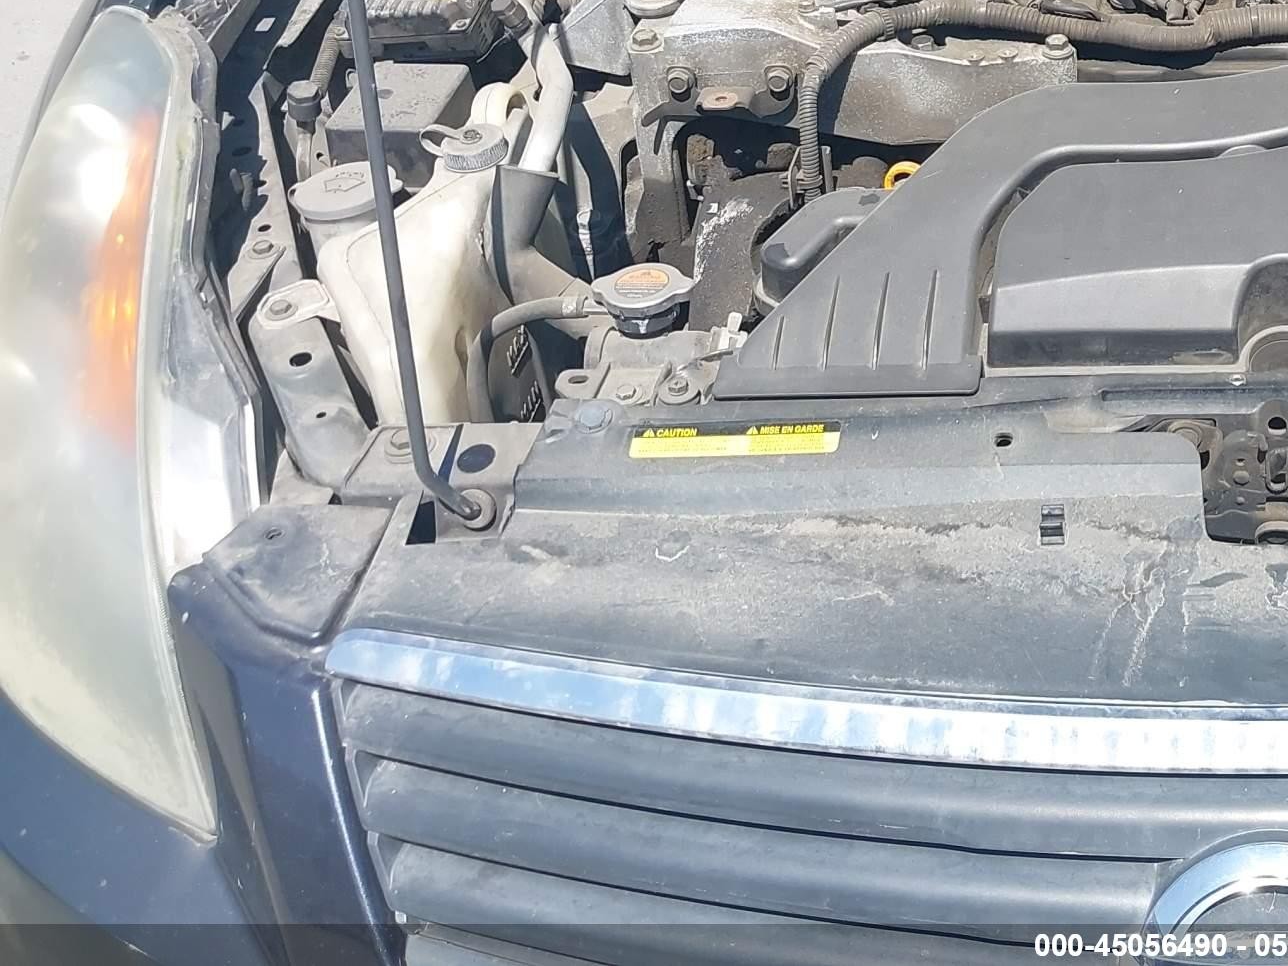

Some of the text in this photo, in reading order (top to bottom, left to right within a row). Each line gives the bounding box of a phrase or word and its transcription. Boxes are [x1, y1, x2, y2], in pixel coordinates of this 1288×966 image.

[656, 428, 698, 438] CAUTION
[759, 424, 825, 435] MISE EN GARDE
